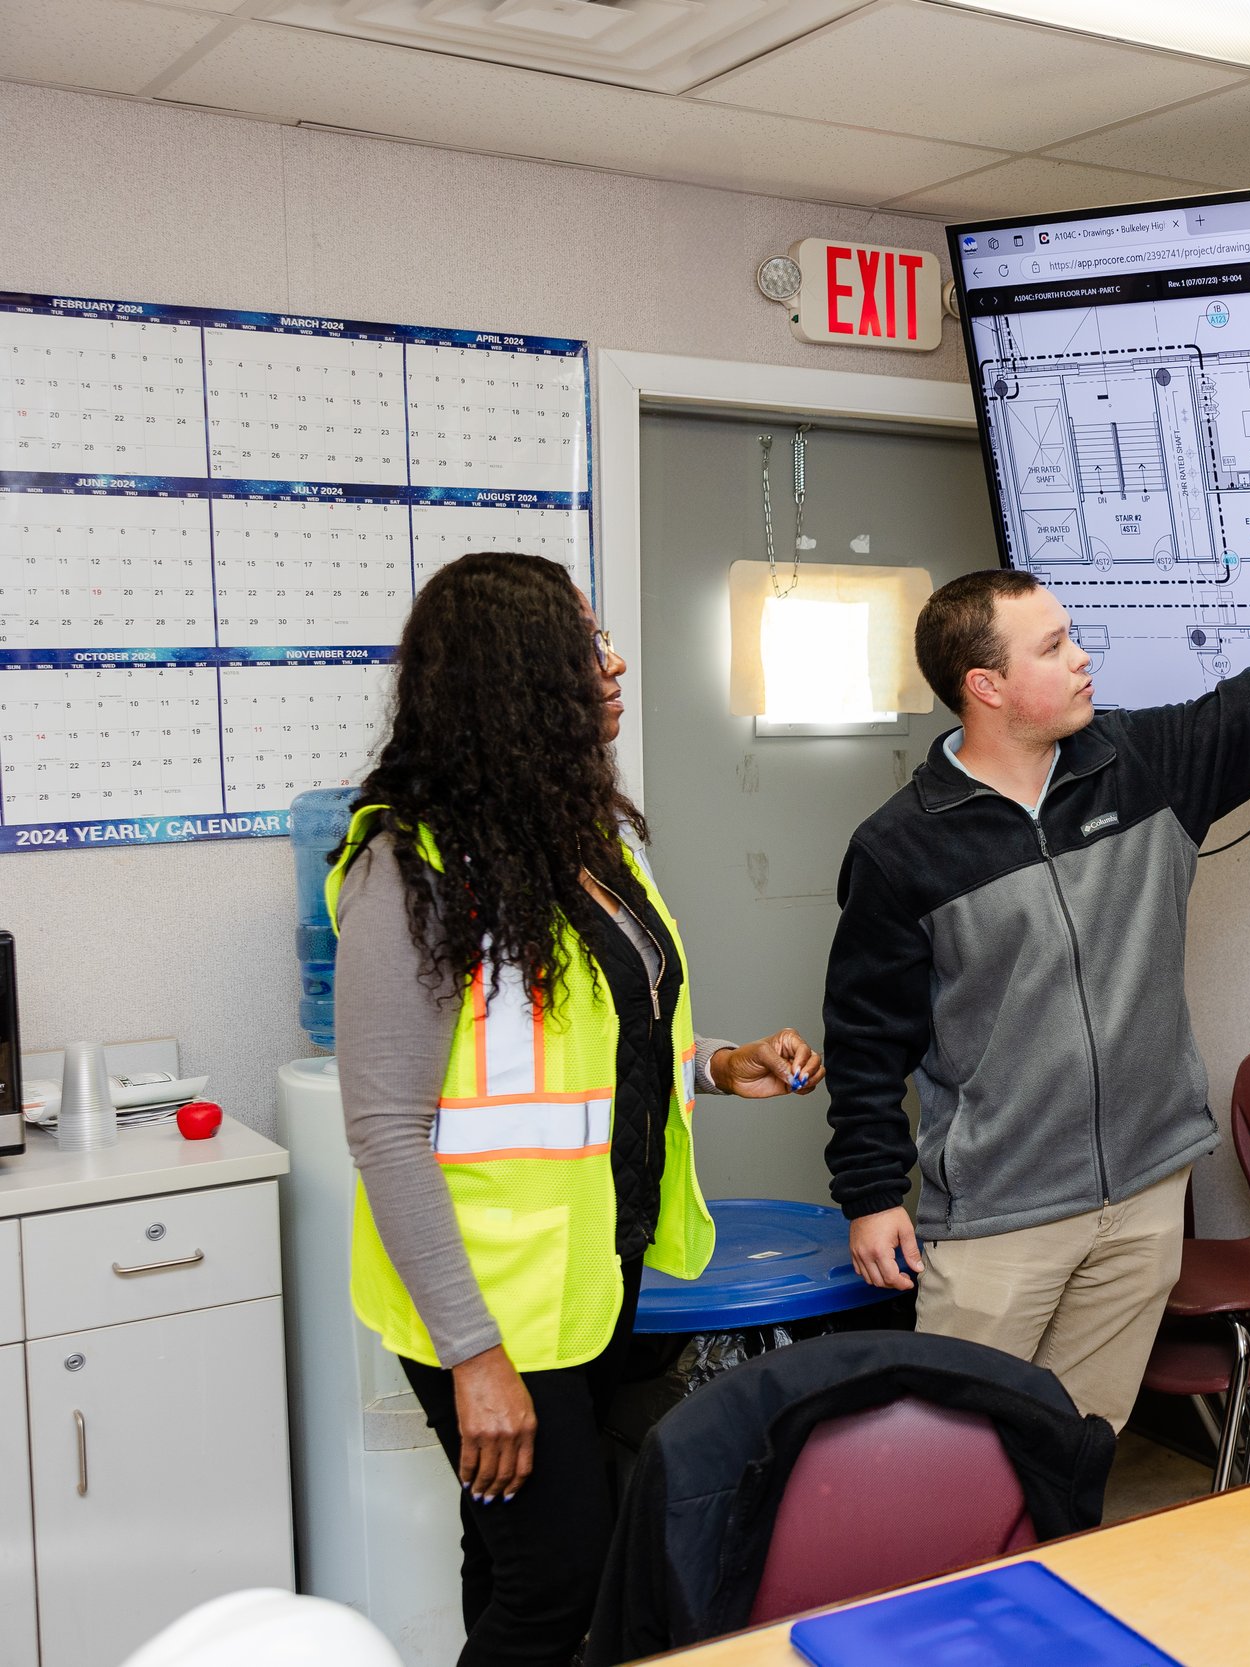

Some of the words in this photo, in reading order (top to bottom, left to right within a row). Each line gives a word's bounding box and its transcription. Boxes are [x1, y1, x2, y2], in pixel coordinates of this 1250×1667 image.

[1054, 229, 1077, 241] A104C
[1082, 227, 1115, 239] Drawings
[1120, 223, 1149, 236] Bulkeley
[1168, 279, 1180, 288] Rev.
[1186, 275, 1218, 287] (07/07/23)
[826, 245, 923, 341] EXIT
[1035, 291, 1060, 300] FOURTH
[1060, 289, 1081, 298] FLOOR
[1081, 288, 1097, 296] PLAN
[1115, 285, 1121, 293] C
[53, 298, 115, 313] FEBRUARY
[117, 304, 144, 314] 2024
[1213, 304, 1222, 313] 1B
[280, 317, 320, 329] MARCH
[321, 321, 345, 331] 2024
[1210, 315, 1227, 325] A123
[475, 333, 502, 344] APRIL
[503, 336, 524, 346] 2024
[1173, 429, 1184, 454] SHAFT
[1041, 465, 1062, 474] RATED
[1177, 455, 1187, 480] RATED
[75, 478, 109, 488] JUNE
[110, 479, 137, 488] 2024
[1036, 475, 1056, 484] SHAFT
[292, 486, 318, 495] JULY
[320, 487, 344, 496] 2024
[1181, 481, 1189, 497] 2HR
[477, 492, 516, 501] AUGUST
[517, 494, 538, 502] 2024
[1141, 495, 1151, 503] UP
[1115, 514, 1134, 522] STAIR
[1037, 526, 1050, 534] 2HR
[1050, 525, 1071, 534] RATED
[1122, 525, 1138, 533] 4ST2
[1045, 535, 1065, 543] SHAFT
[1095, 558, 1110, 566] 4ST2
[1157, 557, 1172, 565] 4ST2
[74, 652, 130, 661] OCTOBER
[131, 652, 157, 661] 2024
[286, 650, 344, 659] NOVEMBER
[345, 649, 368, 658] 2024
[1214, 661, 1228, 669] 4017
[15, 829, 69, 846] 2024
[73, 821, 161, 842] YEARLY
[166, 815, 281, 837] CALENDAR
